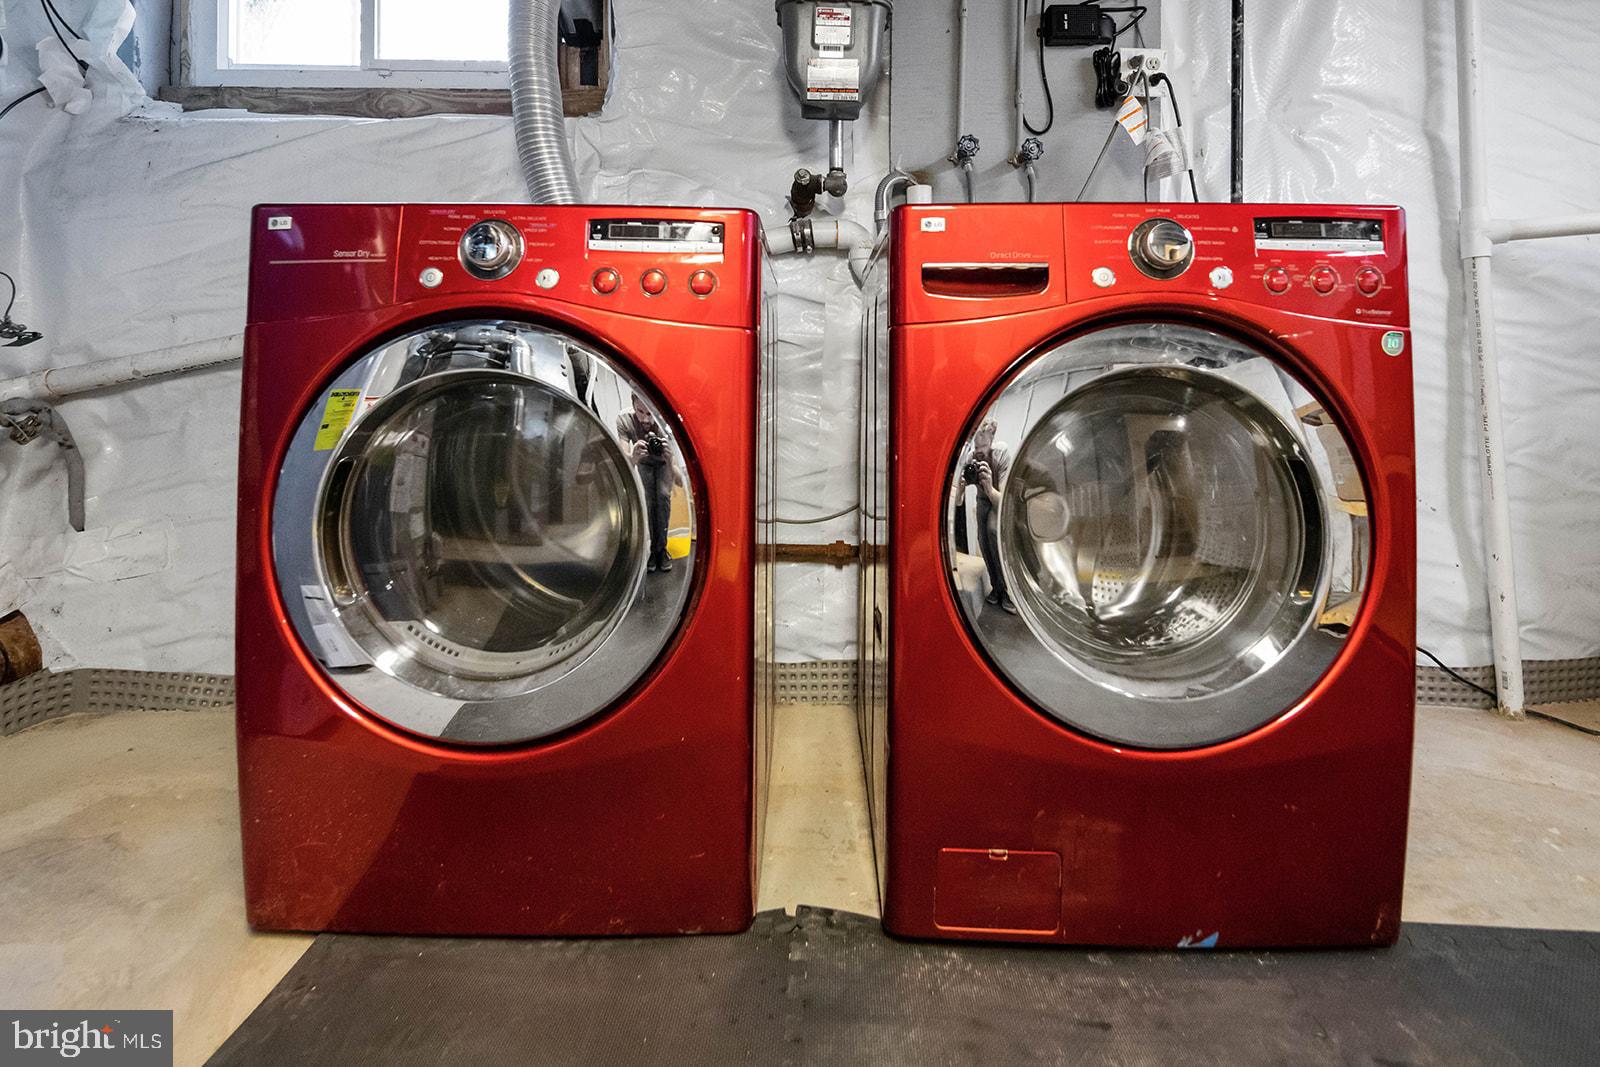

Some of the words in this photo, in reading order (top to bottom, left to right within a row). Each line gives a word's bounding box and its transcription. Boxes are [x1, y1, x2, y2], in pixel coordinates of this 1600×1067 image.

[333, 249, 357, 258] Sensor
[357, 249, 370, 258] Dry
[990, 251, 1012, 259] Direct
[1012, 251, 1032, 259] Drive
